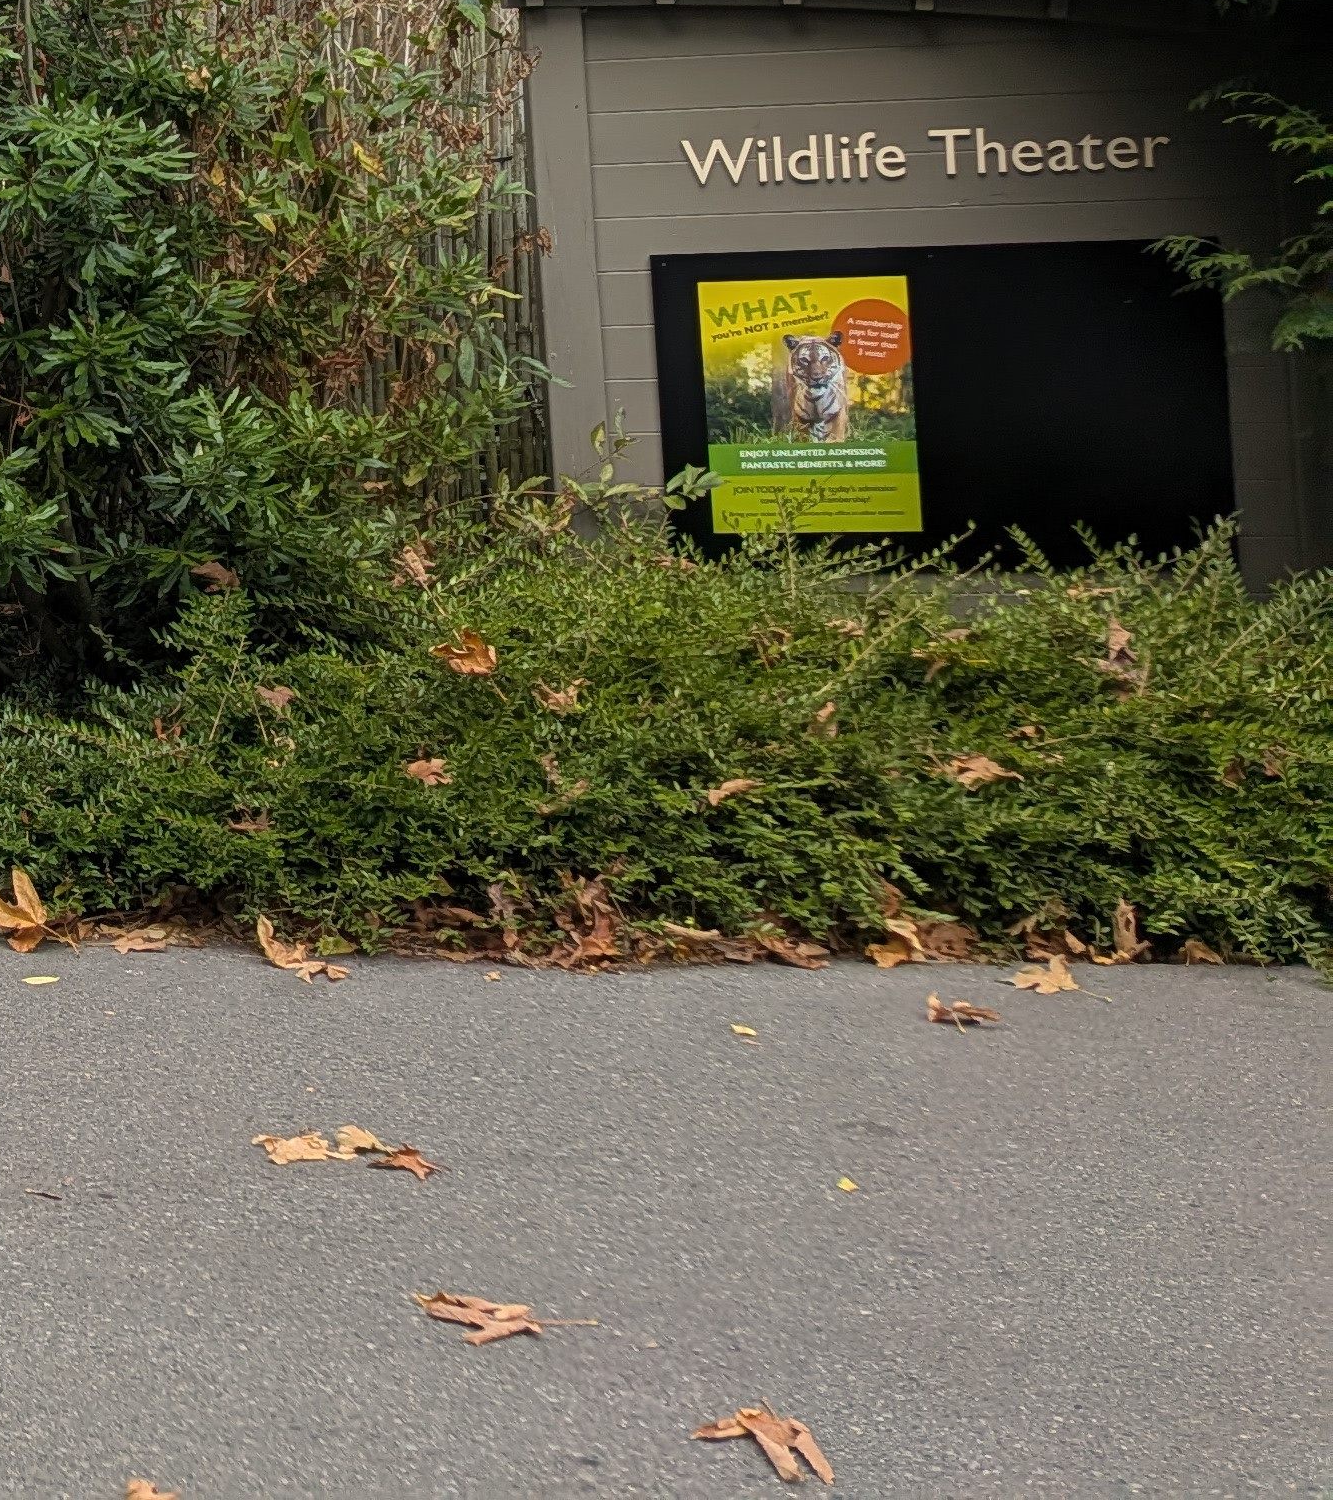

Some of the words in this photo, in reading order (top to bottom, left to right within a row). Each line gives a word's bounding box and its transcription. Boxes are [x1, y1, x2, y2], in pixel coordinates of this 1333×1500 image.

[680, 131, 907, 185] Wildlife
[927, 127, 1171, 177] Theater
[704, 289, 818, 328] WHAT,
[711, 328, 743, 343] you're
[744, 322, 770, 335] NOT
[773, 322, 780, 330] a
[781, 310, 829, 328] member?
[846, 317, 854, 325] A
[855, 319, 903, 331] membership
[867, 328, 880, 337] for
[880, 341, 898, 349] than
[739, 449, 770, 459] ENJOY
[771, 448, 827, 457] UNLIMITED
[741, 461, 796, 469] FANTASTIC
[797, 460, 845, 469] BENEFITS
[845, 460, 853, 468] &
[854, 459, 887, 468] MORE!
[733, 486, 754, 496] JOIN
[756, 485, 786, 494] TODAY
